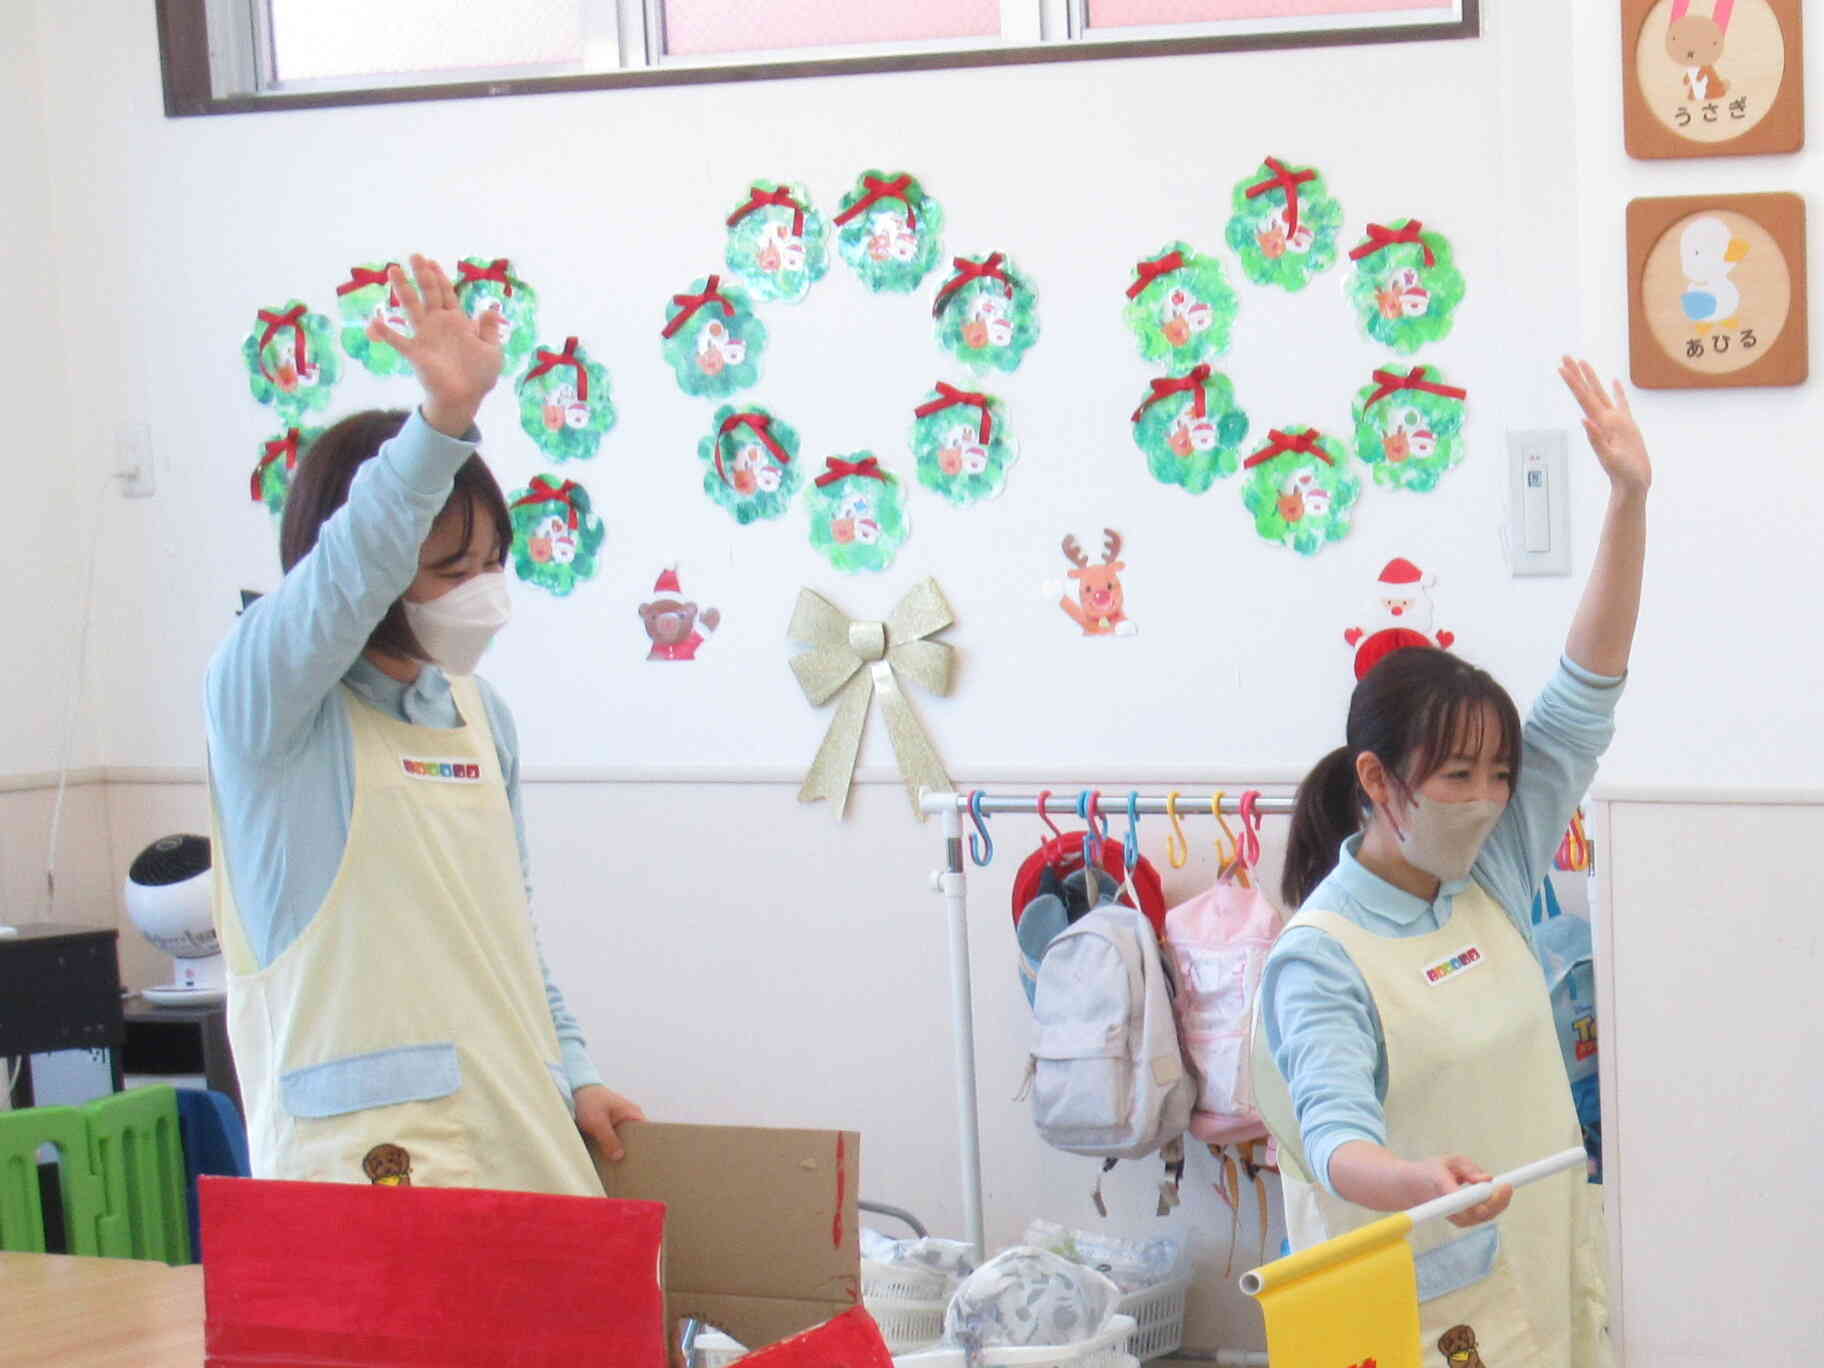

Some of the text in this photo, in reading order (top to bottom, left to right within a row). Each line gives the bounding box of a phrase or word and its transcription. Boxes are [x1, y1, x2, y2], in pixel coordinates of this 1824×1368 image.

[1675, 96, 1748, 127] うさぎ
[1685, 329, 1757, 358] あひる
